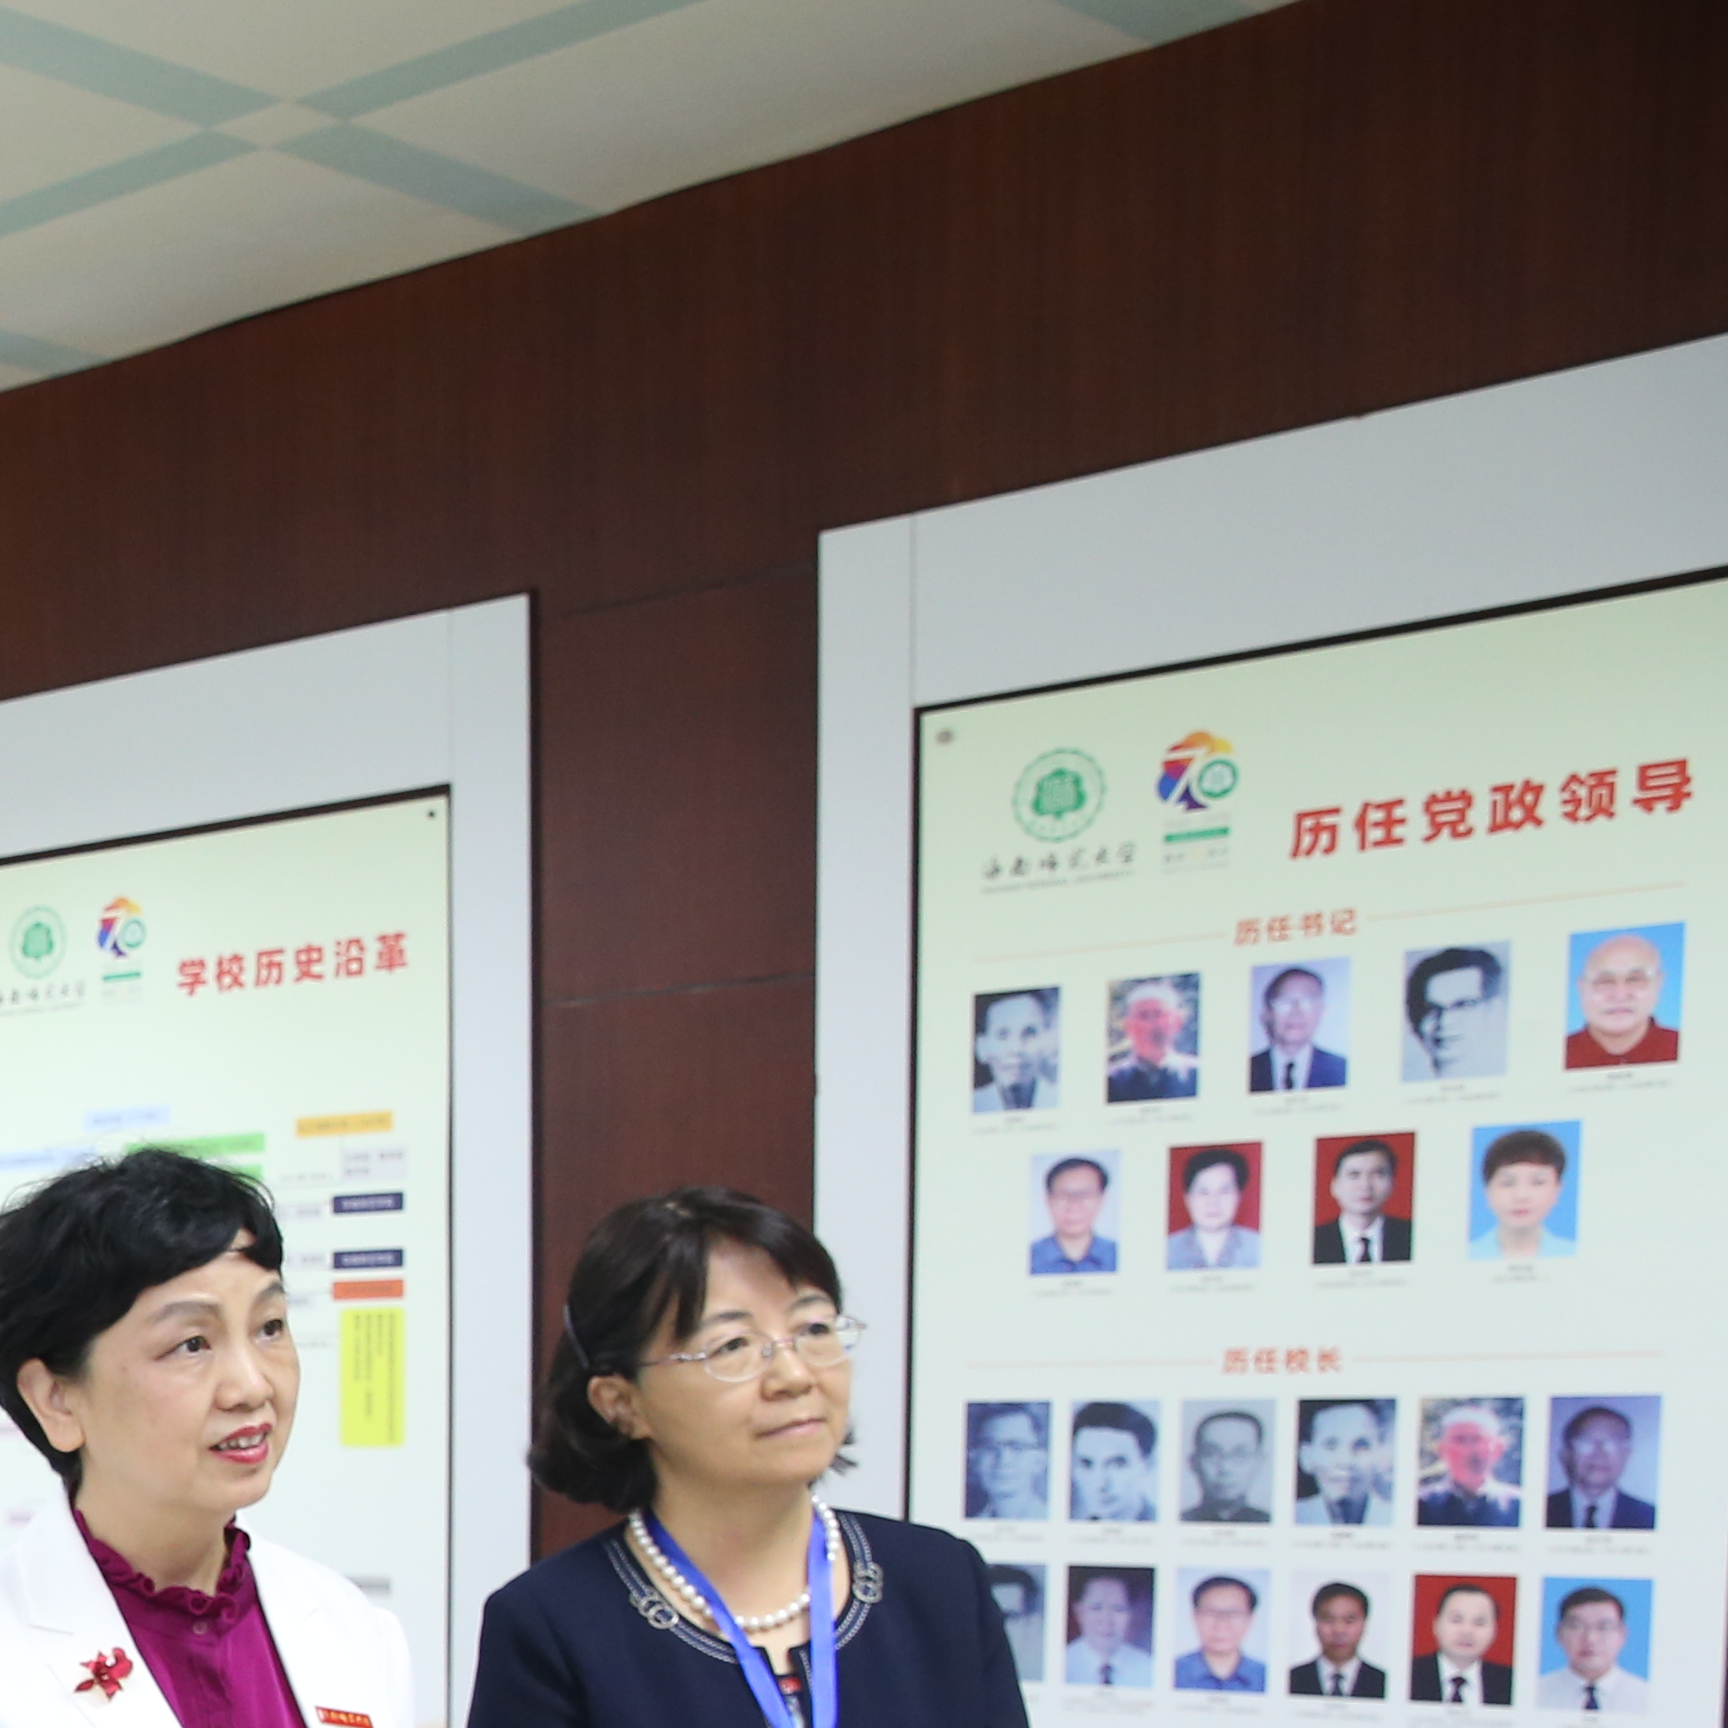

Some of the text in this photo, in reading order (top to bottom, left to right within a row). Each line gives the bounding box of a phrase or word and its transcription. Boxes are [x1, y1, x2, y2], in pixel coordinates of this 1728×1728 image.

[1290, 758, 1693, 860] 历任党政领导
[1233, 908, 1359, 946] 历任书记
[176, 931, 411, 997] 学校历史沿革
[1220, 1345, 1344, 1376] 历任校长
